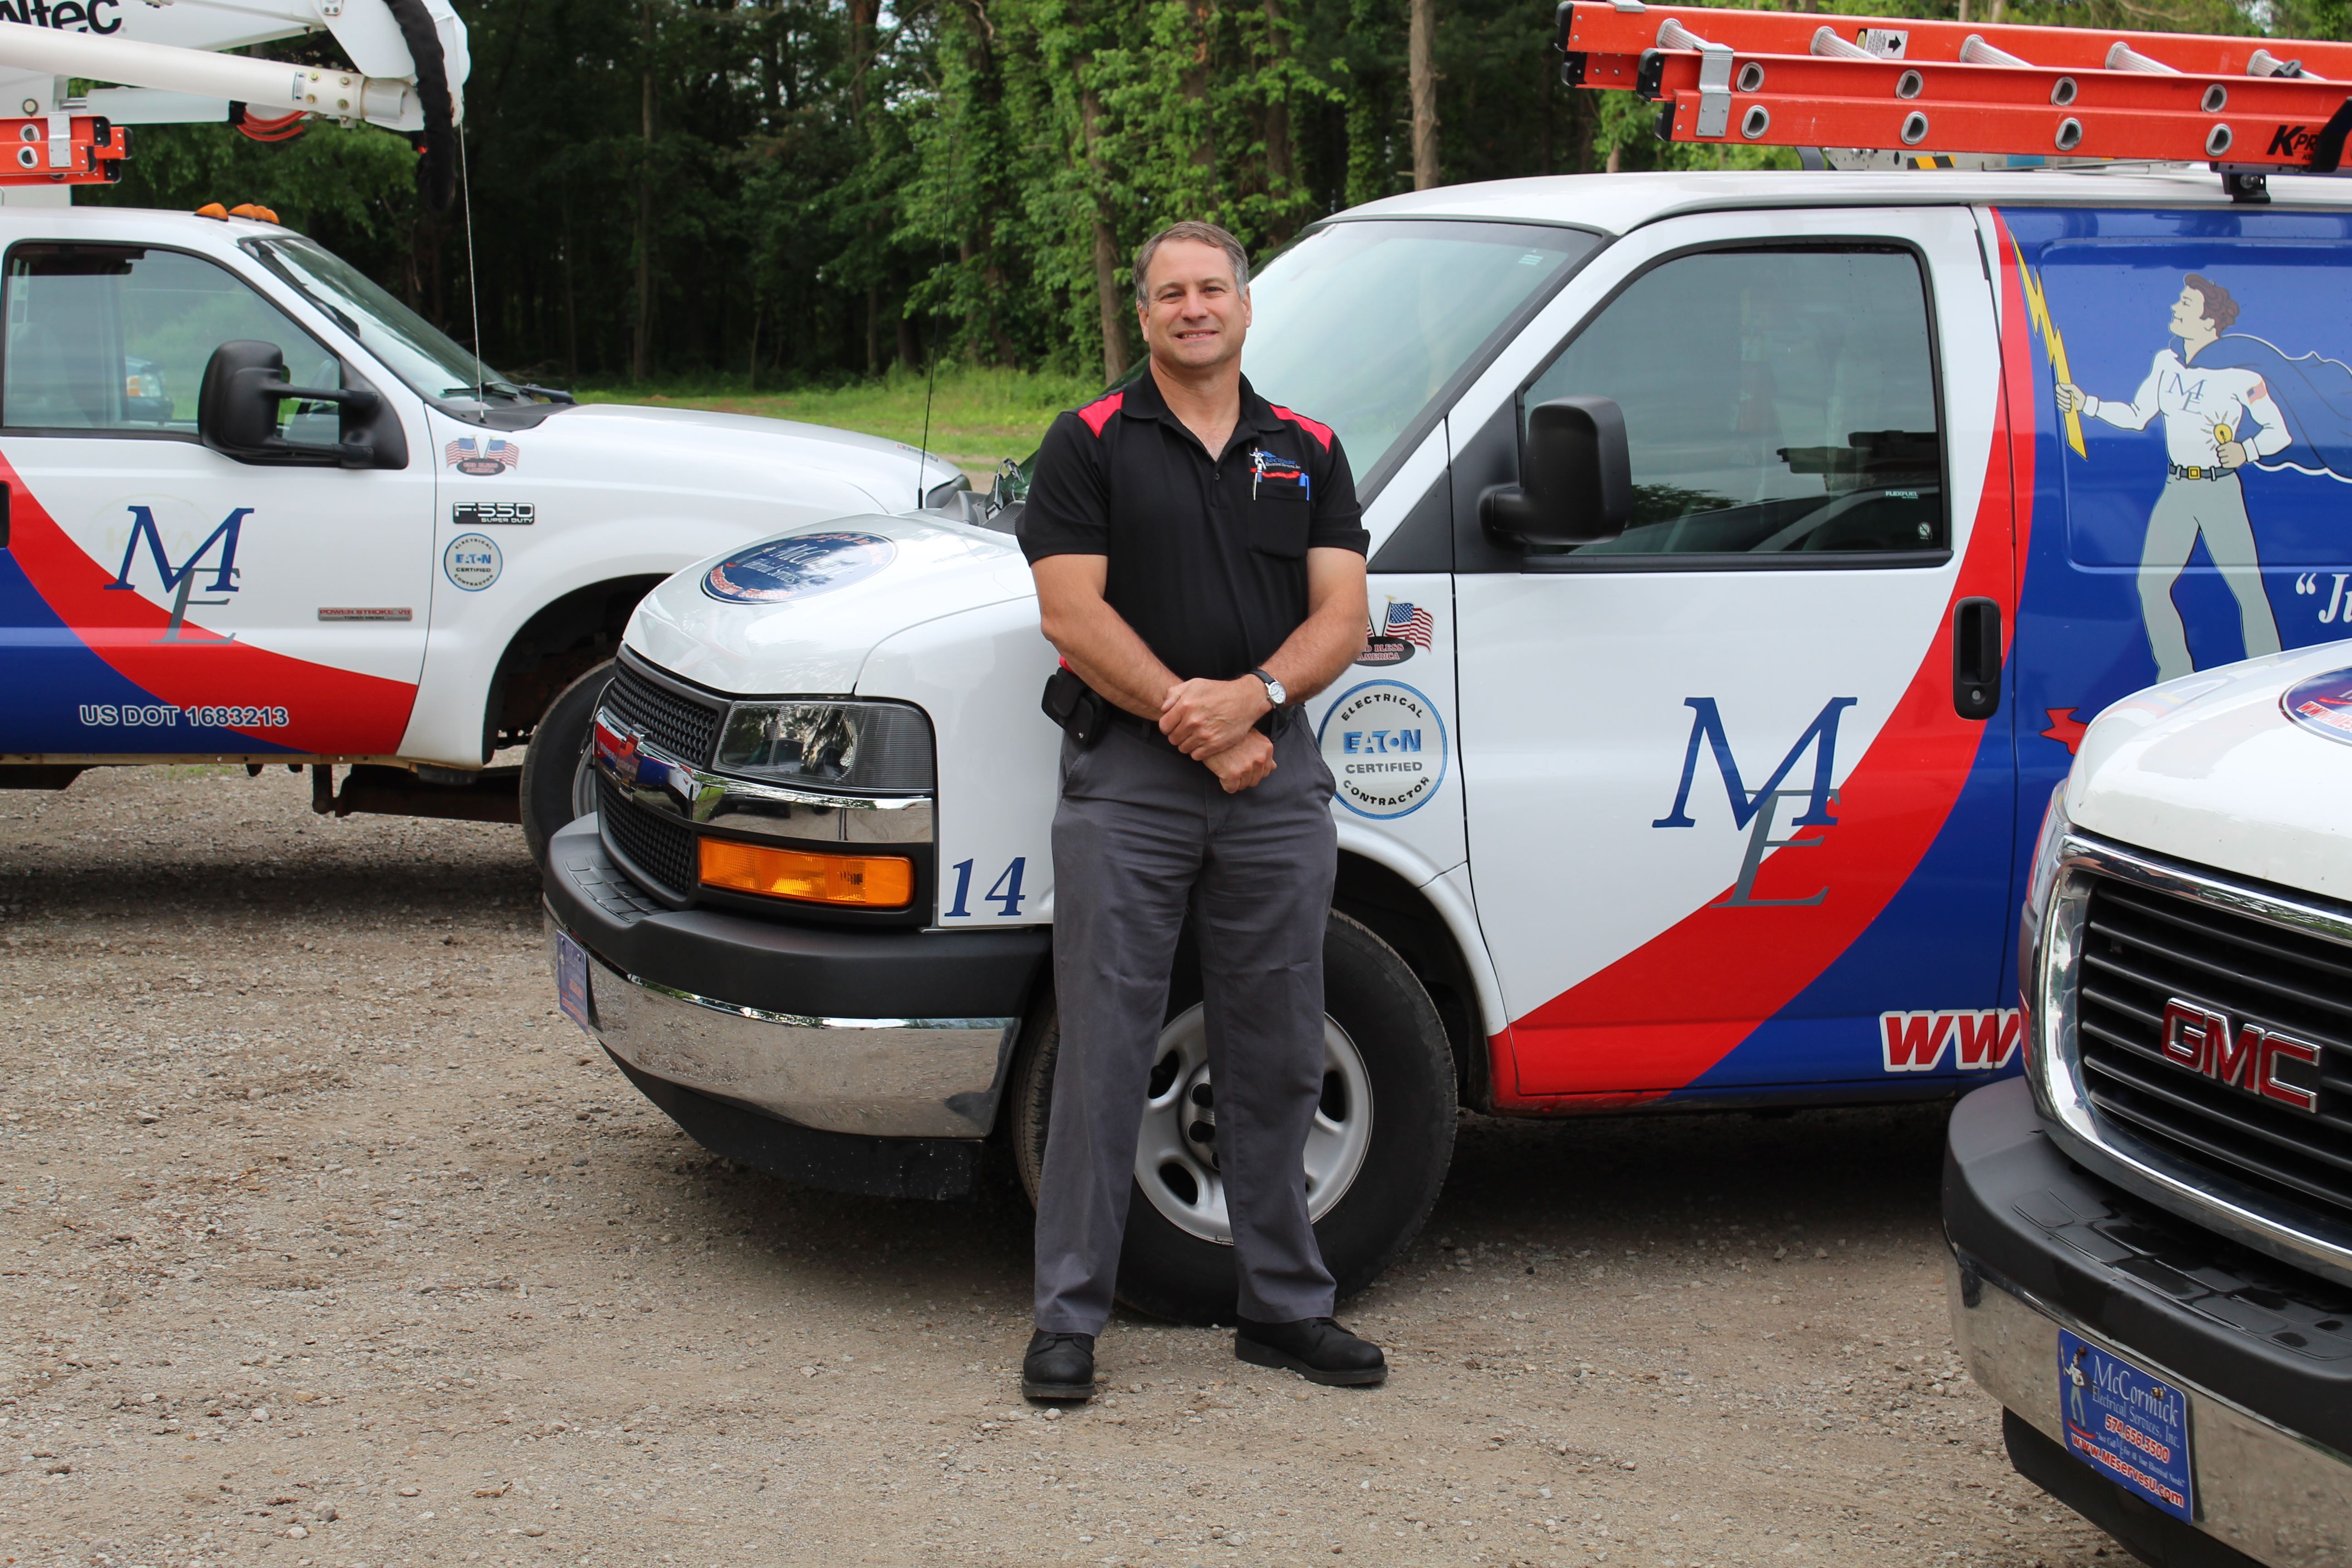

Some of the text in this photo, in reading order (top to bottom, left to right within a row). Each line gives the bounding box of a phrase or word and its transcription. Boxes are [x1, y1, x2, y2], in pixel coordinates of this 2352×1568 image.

[455, 538, 492, 550] ELECTRICAL
[454, 573, 494, 586] CONTRACTOR
[1374, 643, 1404, 652] BLESS
[79, 705, 289, 727] US DOT 1683213
[1341, 693, 1424, 721] ELECTRICAL
[1343, 729, 1421, 754] EATON
[1345, 761, 1423, 774] CERTIFIED
[1343, 776, 1430, 806] CONTRACTOR
[944, 857, 1026, 916] 14
[2161, 997, 2322, 1113] GMC
[2092, 1354, 2179, 1428] McCormick
[2092, 1384, 2180, 1449] Electrical Services, Inc.
[2105, 1413, 2170, 1464] 574.656.3500
[2071, 1432, 2185, 1509] www.MEservesU.com
